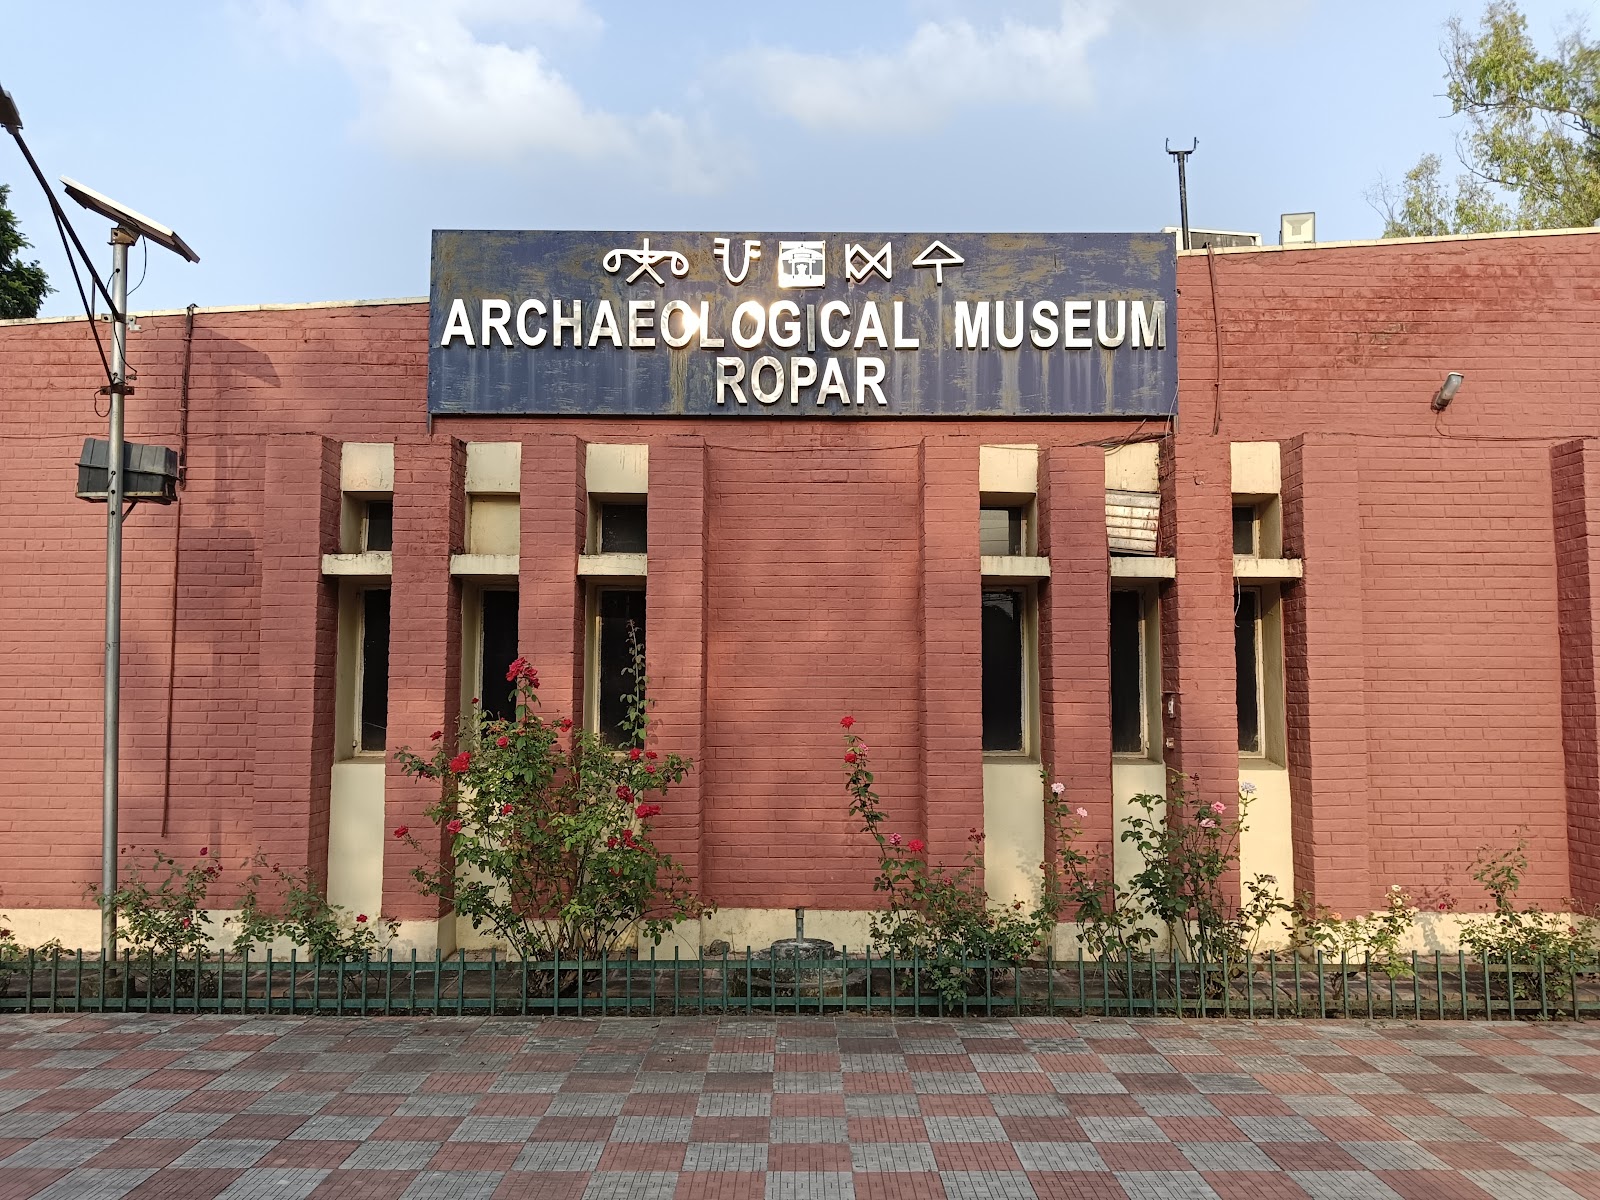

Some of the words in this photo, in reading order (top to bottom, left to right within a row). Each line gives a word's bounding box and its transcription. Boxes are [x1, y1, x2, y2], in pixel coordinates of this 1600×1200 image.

[440, 298, 921, 350] ARCHAEOLOGICAL
[953, 299, 1166, 350] MUSEUM
[715, 356, 888, 405] ROPAR
